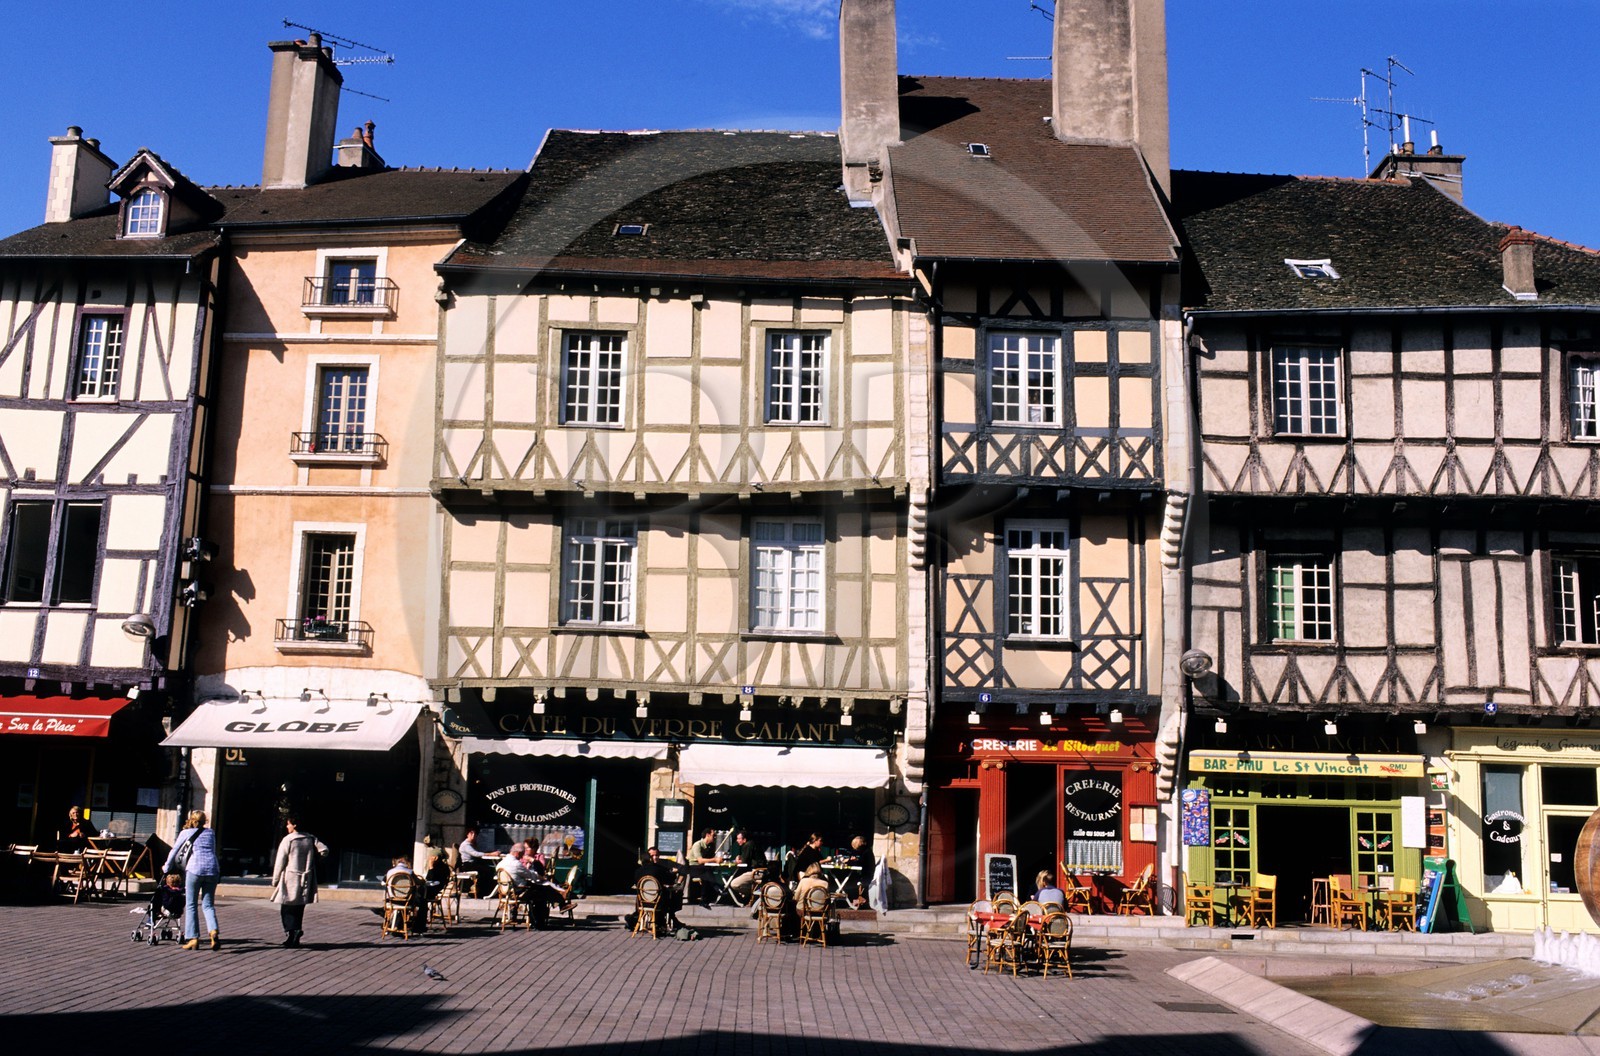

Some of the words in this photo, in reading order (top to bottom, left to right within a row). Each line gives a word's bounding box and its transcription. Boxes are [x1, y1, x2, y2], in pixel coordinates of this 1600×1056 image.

[29, 669, 38, 677] 12
[744, 686, 752, 694] 8
[982, 694, 989, 702] 6
[8, 717, 29, 730] Sur
[32, 719, 43, 731] la
[225, 720, 364, 734] GLOBE
[581, 717, 616, 736] DU
[630, 718, 723, 739] VERRE
[735, 720, 840, 742] GALANT
[1203, 759, 1227, 771] BAR
[1236, 759, 1263, 772] PMU
[1273, 761, 1290, 772] Le
[1294, 761, 1310, 773] St
[1314, 761, 1369, 774] Vincent
[485, 787, 505, 801] VINS
[505, 784, 518, 794] DE
[519, 783, 577, 804] PROPRIETAIRES
[1065, 778, 1122, 798] CREPERIE
[490, 802, 512, 818] COTE
[514, 804, 572, 823] CHALONNAISE
[1065, 802, 1122, 822] RESTAURANT
[1502, 820, 1511, 831] &
